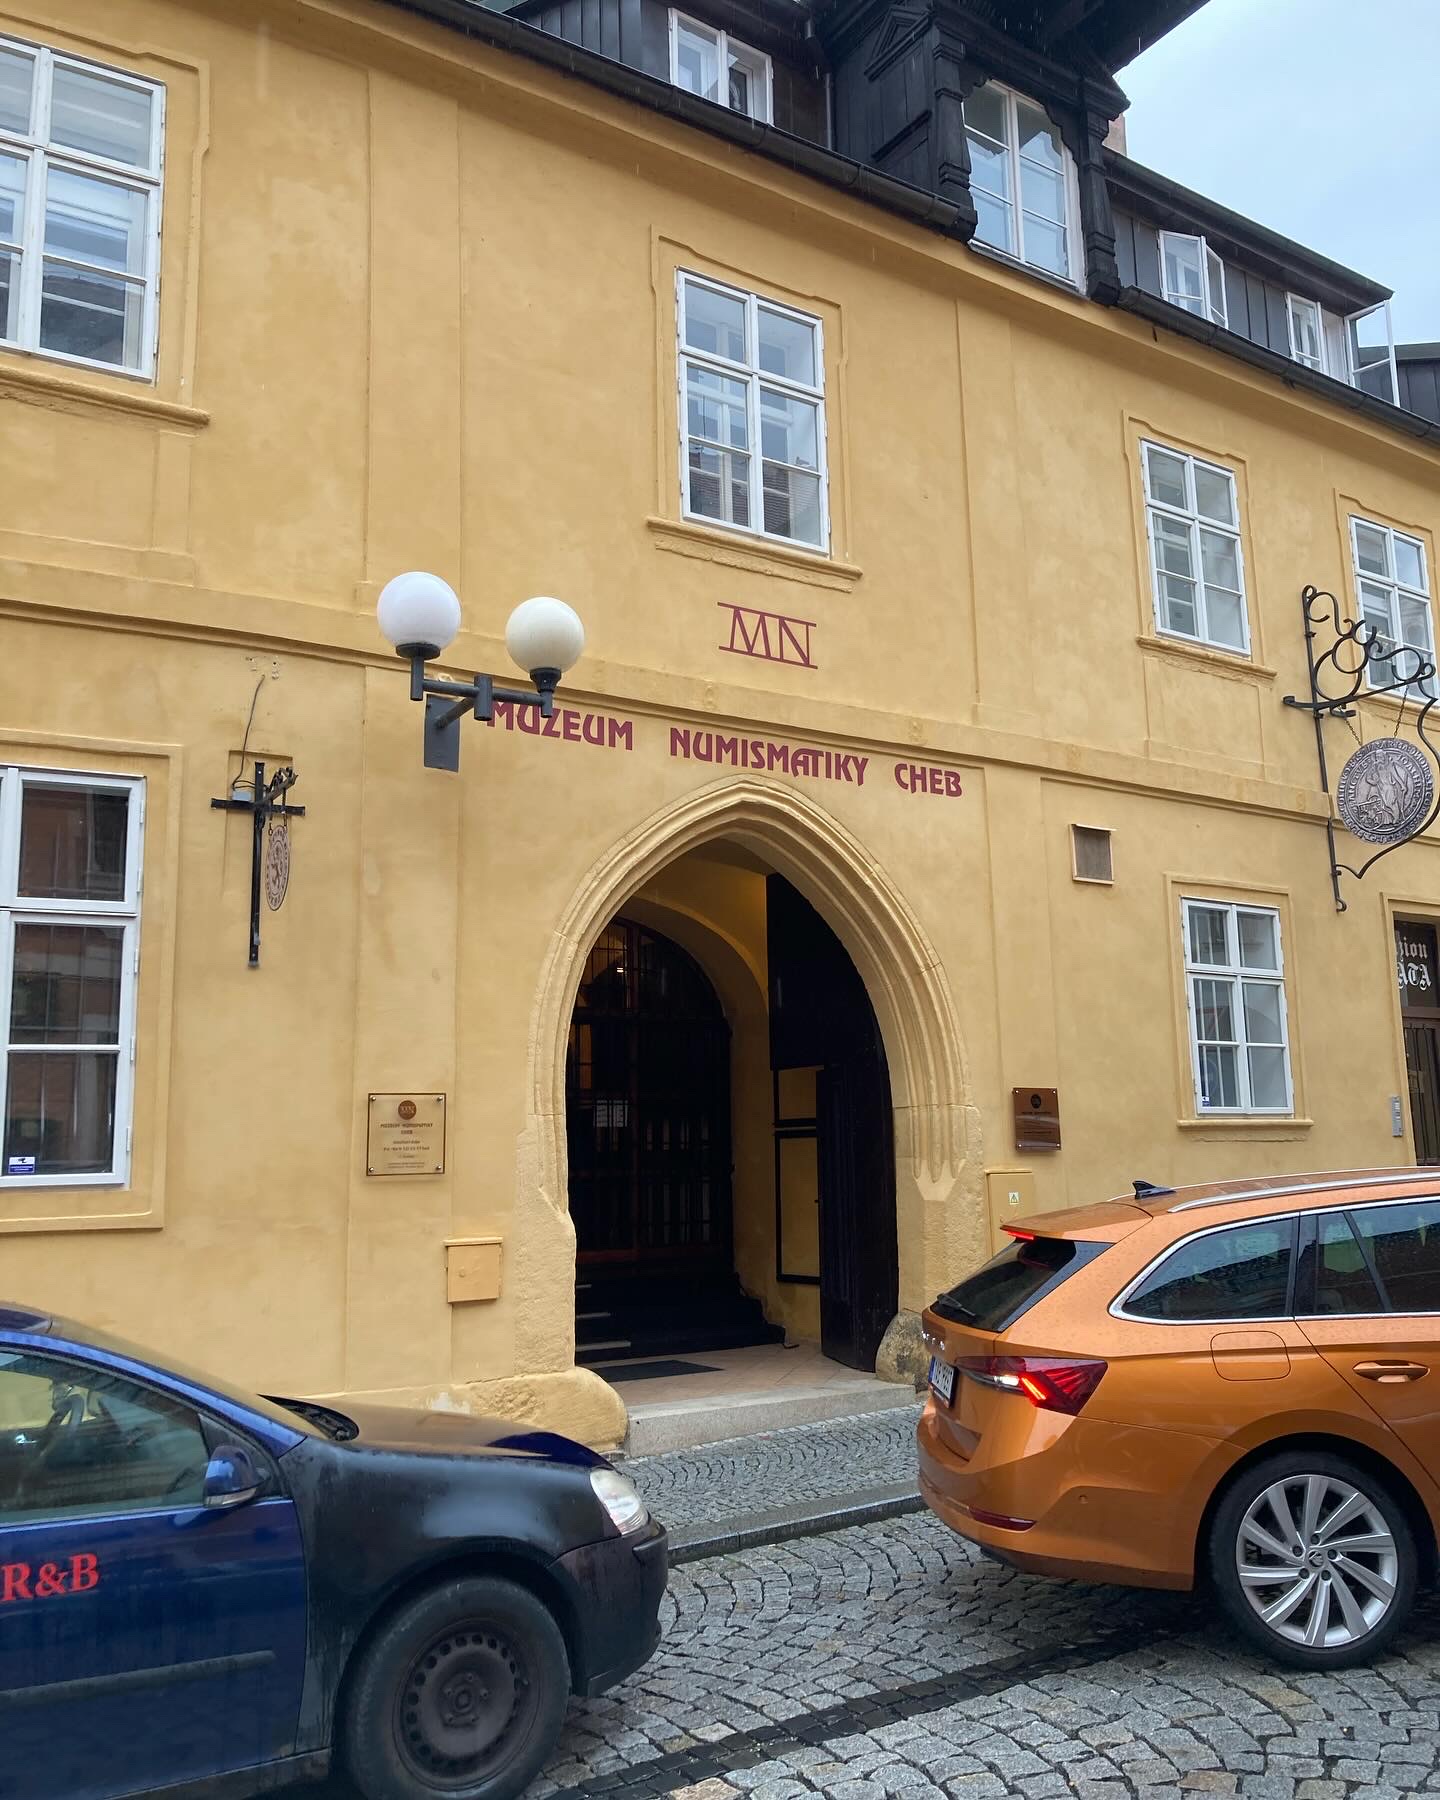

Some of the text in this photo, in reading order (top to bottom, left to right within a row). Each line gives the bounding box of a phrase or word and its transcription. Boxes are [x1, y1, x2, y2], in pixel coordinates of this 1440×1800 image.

[717, 601, 818, 669] MN
[487, 701, 963, 798] MUZEUM NUMISMATIKY CHEB
[0, 1552, 99, 1603] R&B
